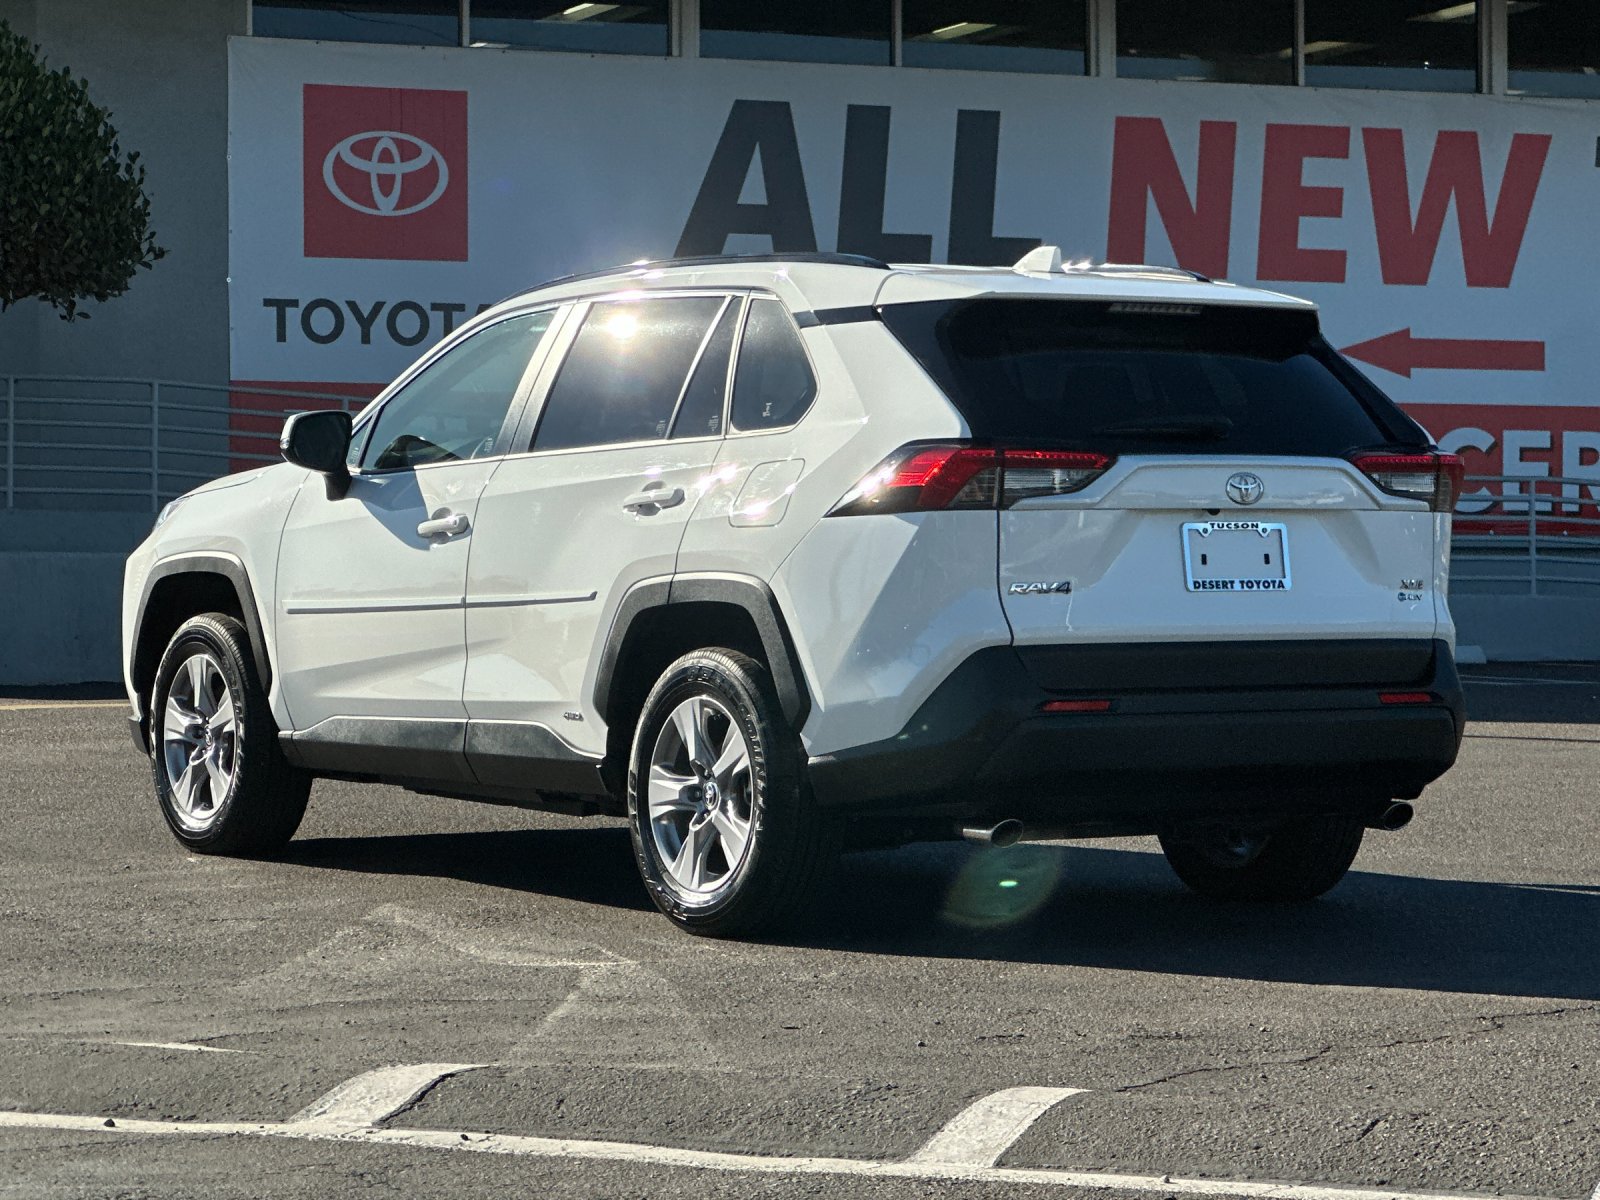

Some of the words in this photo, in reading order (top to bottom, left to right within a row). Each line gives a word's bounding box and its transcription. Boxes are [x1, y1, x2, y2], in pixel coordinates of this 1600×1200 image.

[673, 98, 1042, 266] ALL
[1106, 116, 1552, 289] NEW
[263, 298, 496, 347] TOYOT
[1209, 522, 1259, 530] TUCSON
[1008, 581, 1072, 596] RAV4
[1193, 579, 1235, 590] DESERT
[1239, 579, 1286, 590] TOYOTA
